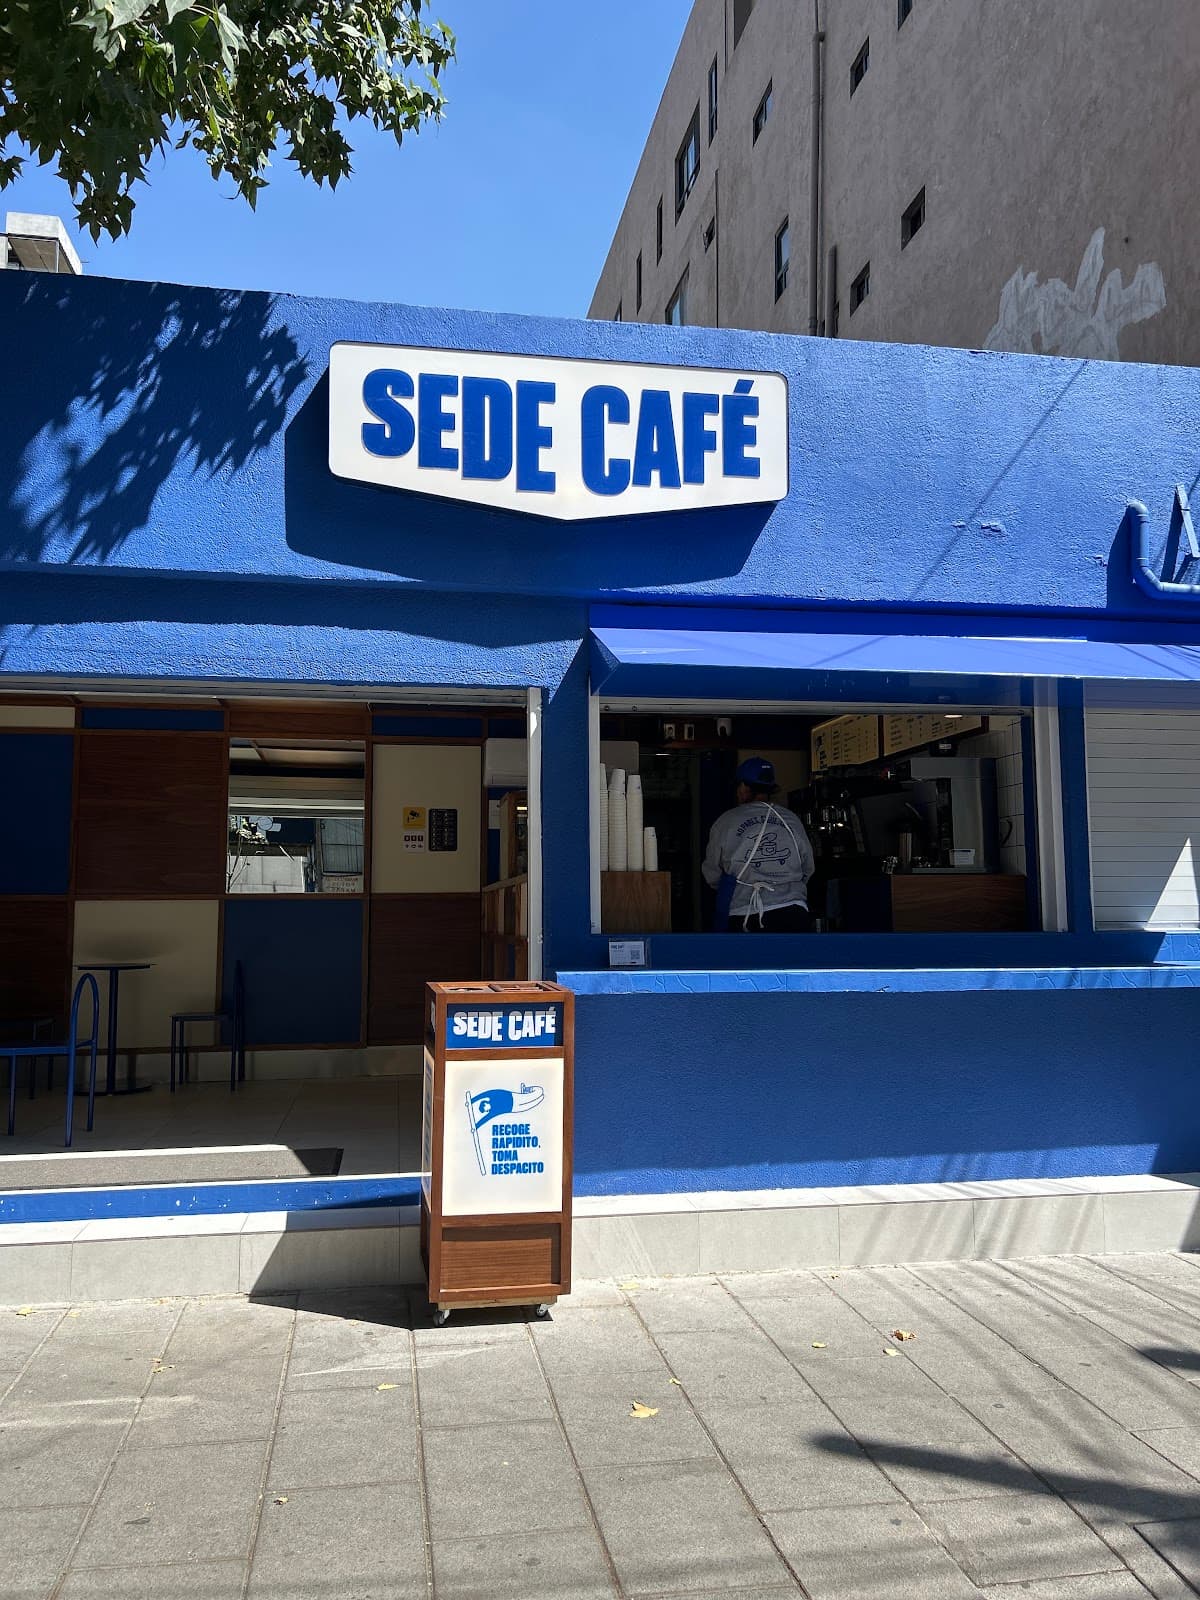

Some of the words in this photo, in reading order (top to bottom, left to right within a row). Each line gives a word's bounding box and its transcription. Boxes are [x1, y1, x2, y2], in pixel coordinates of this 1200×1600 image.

[361, 368, 556, 494] SEDE
[581, 379, 761, 496] CAFÉ
[453, 1011, 503, 1041] SEDE
[508, 1006, 556, 1041] CAFÉ
[491, 1123, 531, 1137] RECOGE
[491, 1149, 519, 1162] TOMA
[491, 1161, 545, 1175] DESPACITO
